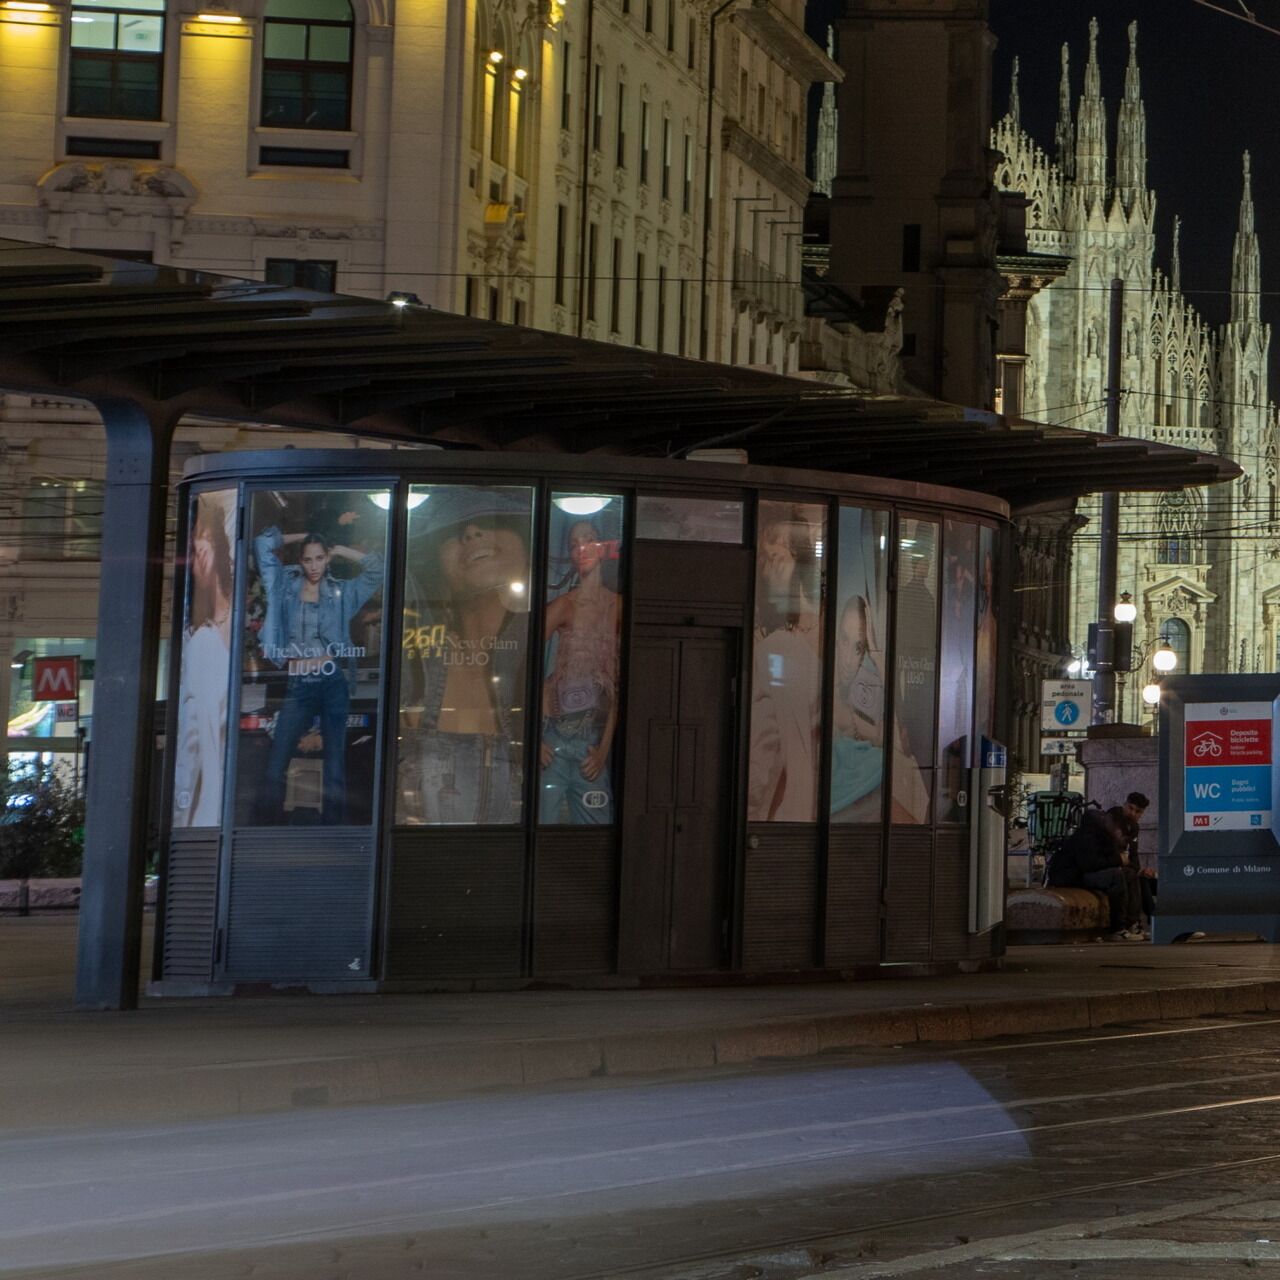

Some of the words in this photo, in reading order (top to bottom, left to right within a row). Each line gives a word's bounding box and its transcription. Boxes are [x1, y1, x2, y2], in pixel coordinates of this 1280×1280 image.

[259, 642, 289, 658] The
[289, 642, 323, 658] New
[325, 641, 367, 658] Glam
[38, 666, 72, 693] M
[1051, 689, 1085, 698] pedonale
[1230, 729, 1259, 738] Deposito
[1230, 736, 1260, 744] biciclette
[1193, 782, 1221, 800] WC
[1196, 866, 1231, 874] Comune
[1232, 865, 1242, 873] di
[1243, 864, 1272, 873] Milano
